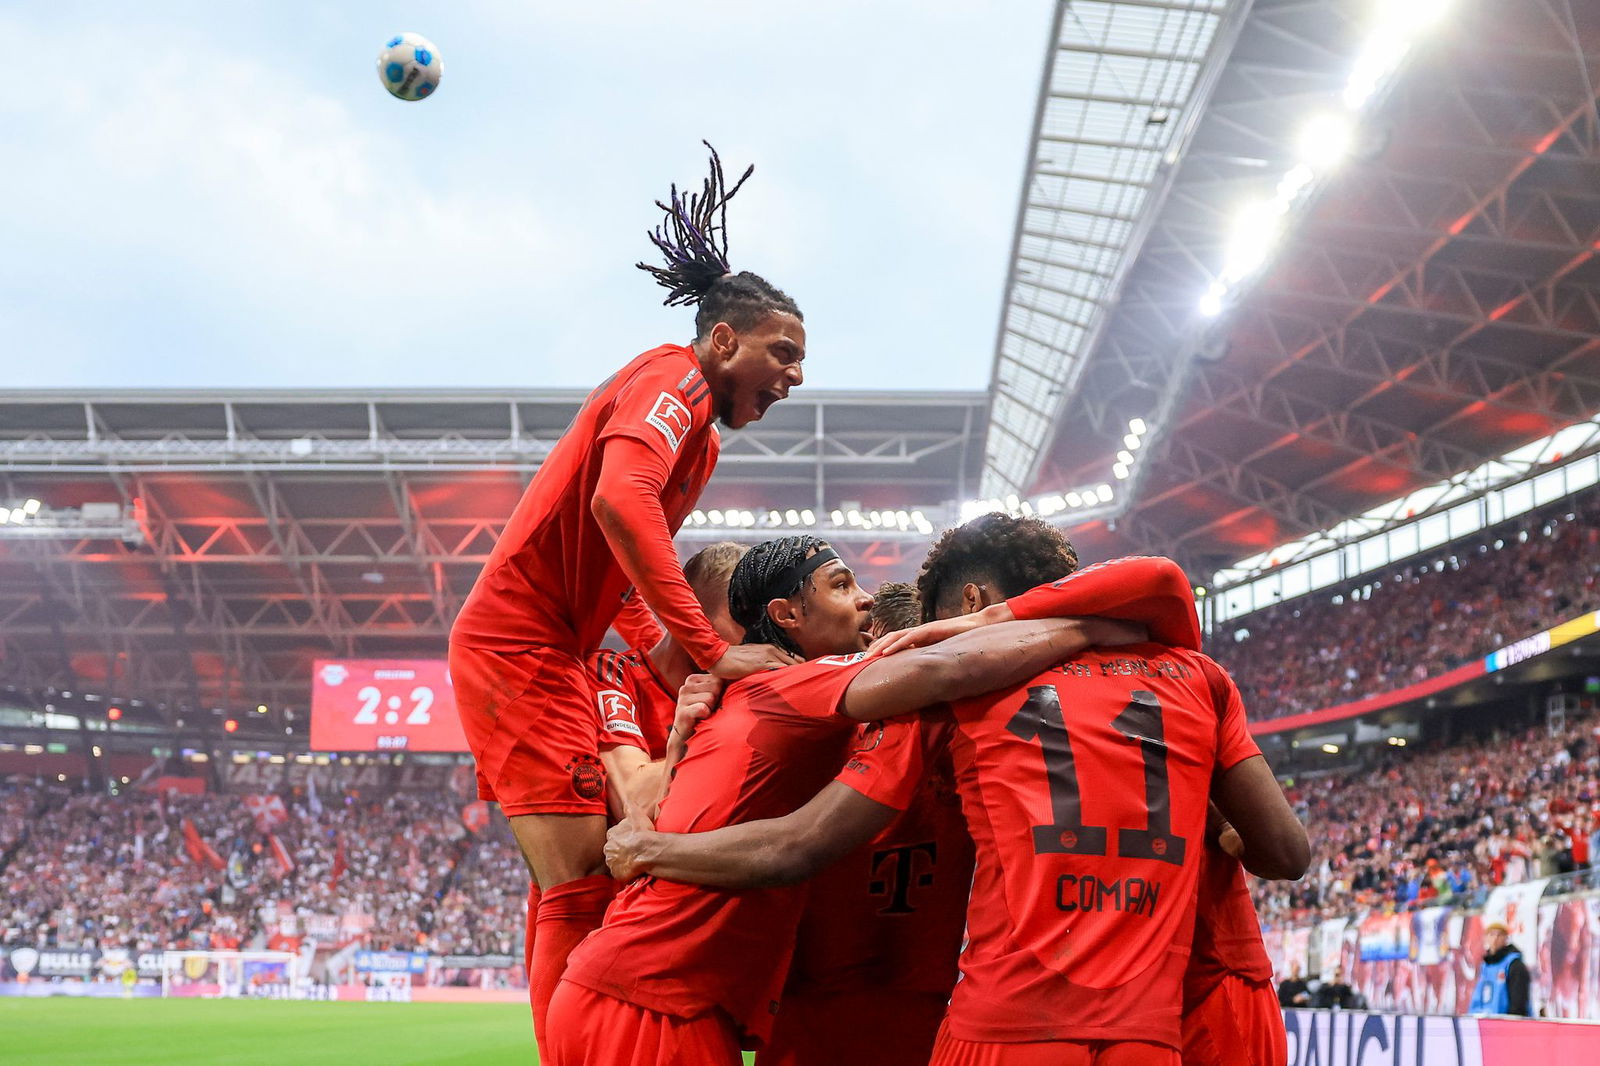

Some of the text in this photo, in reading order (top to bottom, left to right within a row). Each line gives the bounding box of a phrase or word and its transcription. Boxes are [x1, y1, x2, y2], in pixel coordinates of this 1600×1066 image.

[353, 686, 434, 724] 2:2
[1004, 684, 1186, 866] 11
[1056, 874, 1161, 918] COMAN
